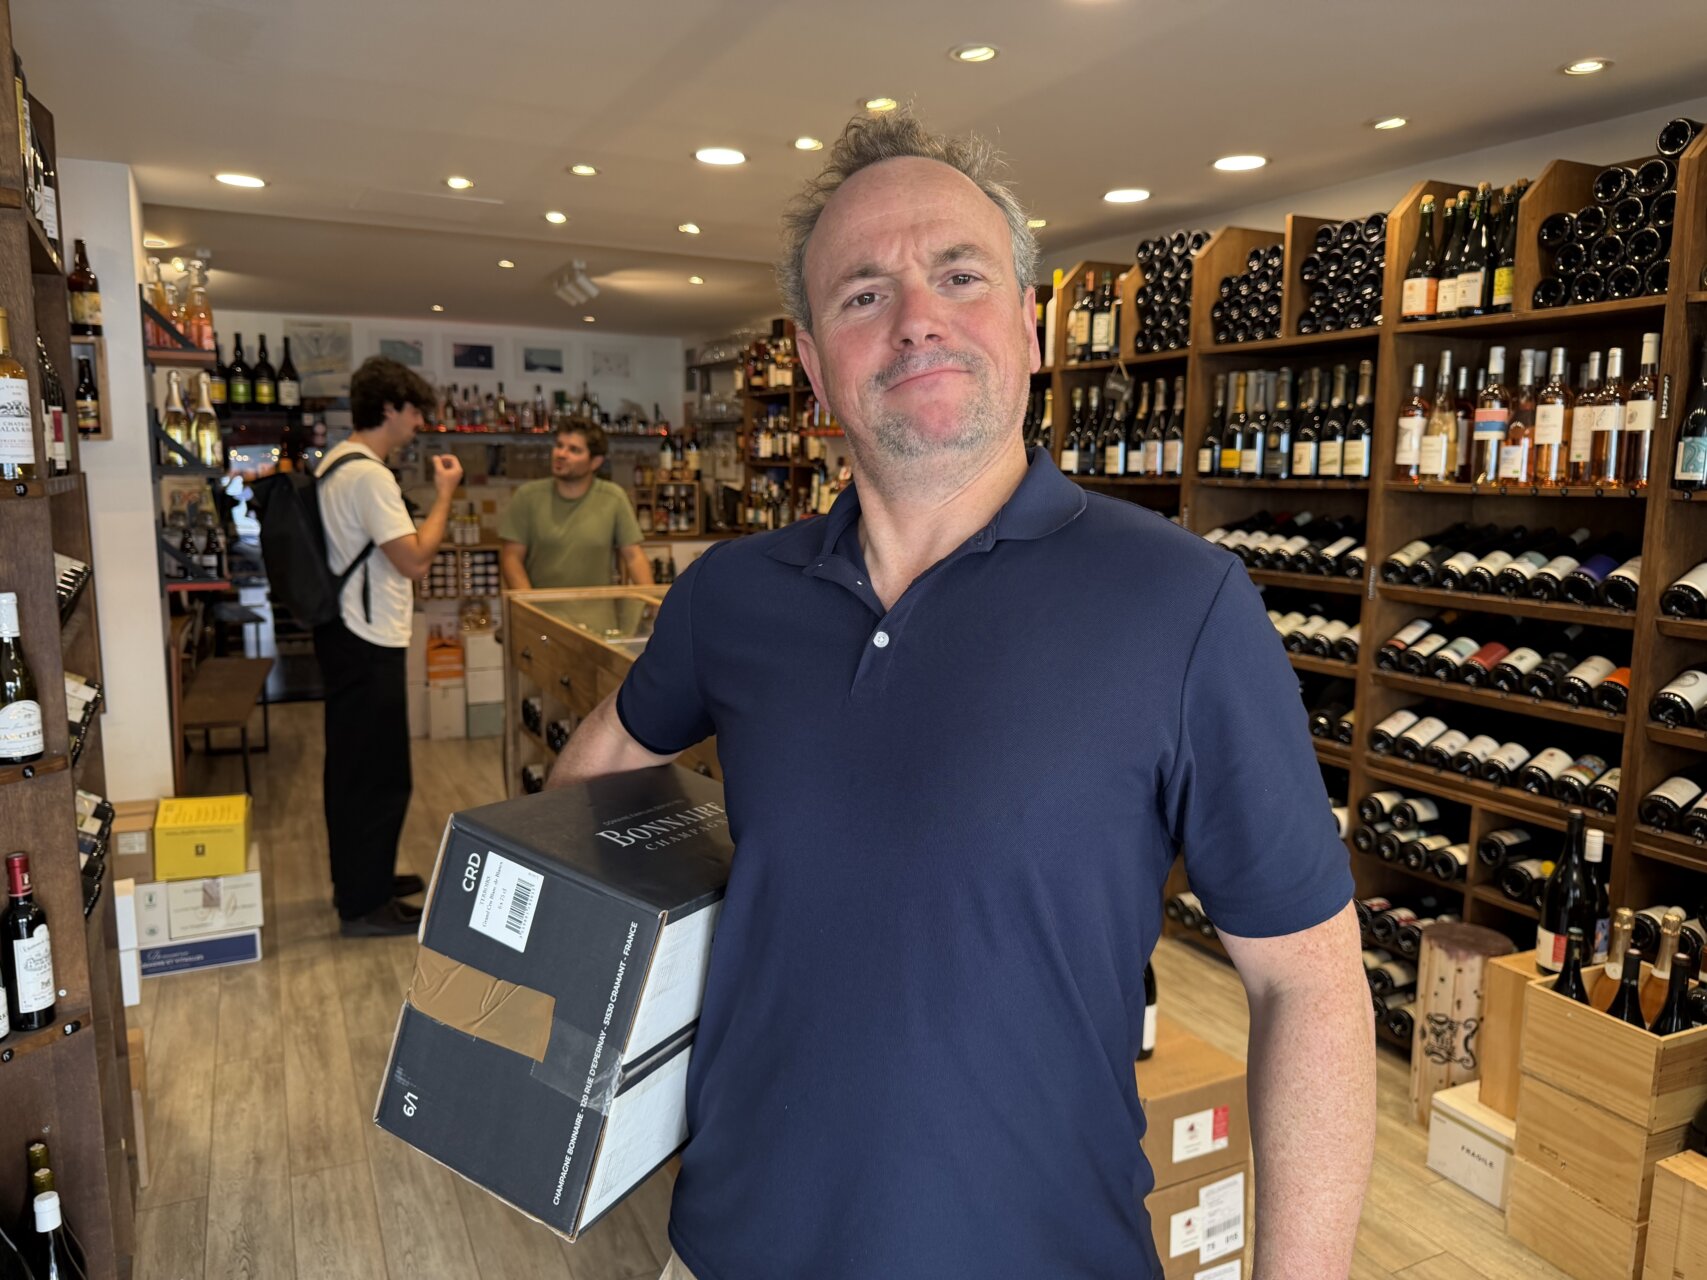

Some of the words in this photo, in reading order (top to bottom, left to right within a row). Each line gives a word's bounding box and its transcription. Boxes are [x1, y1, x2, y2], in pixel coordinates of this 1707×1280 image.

[595, 801, 725, 848] BONNAIRE
[645, 815, 728, 851] CHAMPAGN
[462, 852, 481, 892] CRD
[623, 921, 638, 957] FRANCE
[610, 961, 627, 1003] CRAMANT
[603, 1003, 615, 1026] 51530
[589, 1031, 607, 1077] D'EPERNAY
[580, 1095, 589, 1108] 120
[584, 1077, 595, 1095] RUE
[403, 1091, 419, 1118] 6/1
[567, 1112, 584, 1156] BONNAIRE
[1460, 1145, 1495, 1169] FRAGILE
[552, 1156, 572, 1206] CHAMPAGNE
